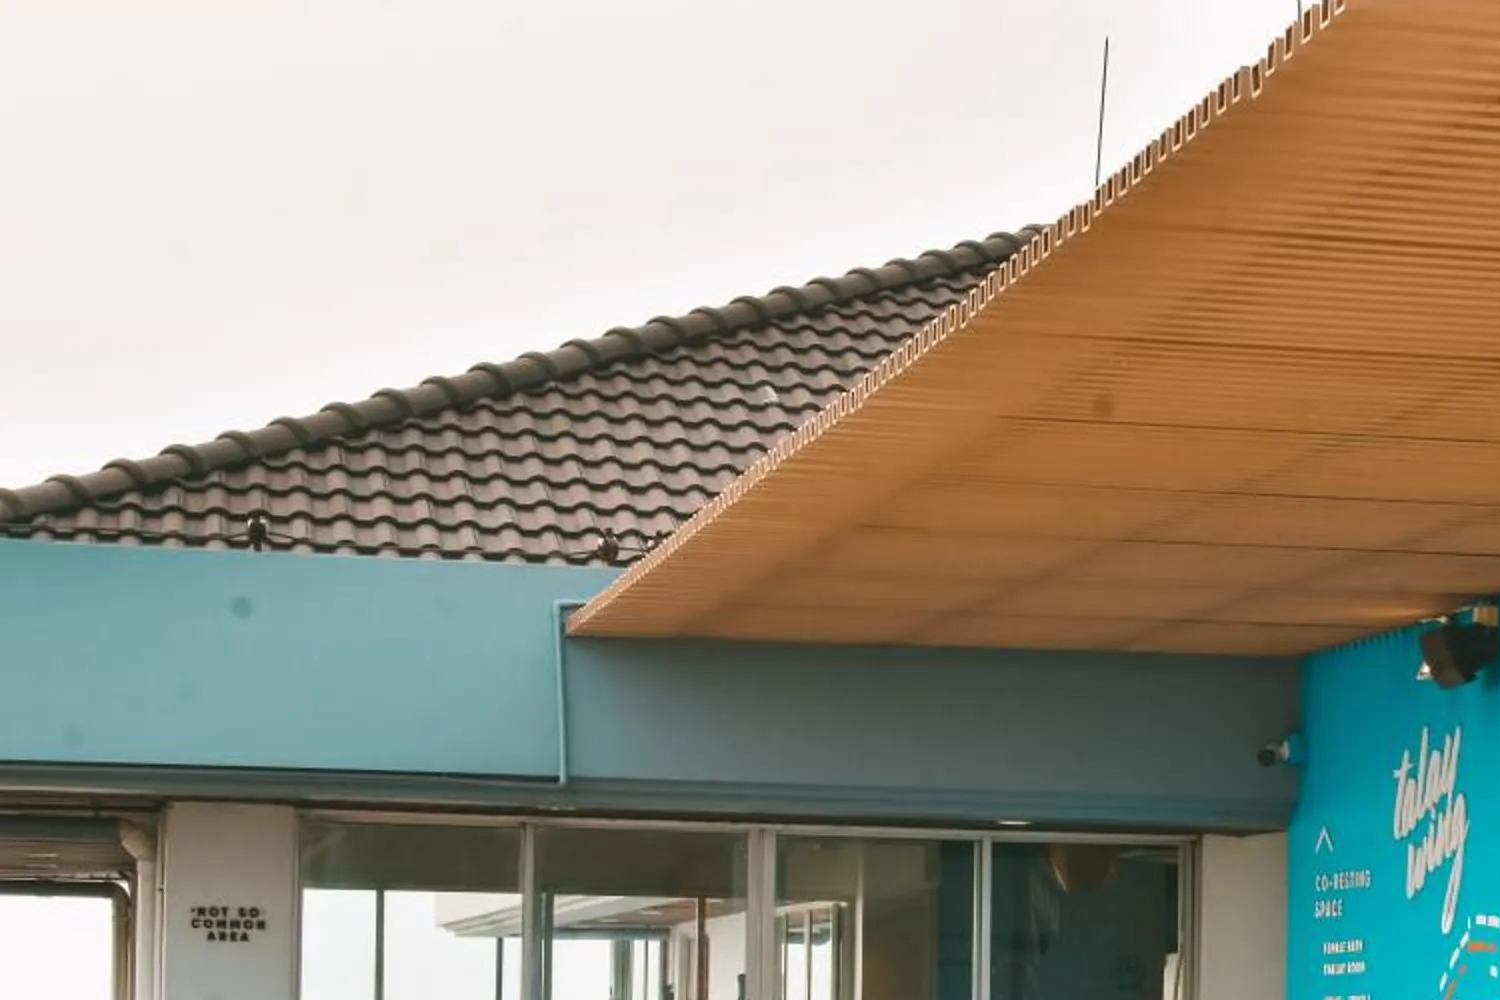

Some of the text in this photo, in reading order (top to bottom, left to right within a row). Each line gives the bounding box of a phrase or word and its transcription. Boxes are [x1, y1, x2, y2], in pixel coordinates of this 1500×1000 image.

[1314, 898, 1343, 919] SPACE
[191, 918, 267, 930] COMMON
[206, 931, 249, 942] AREA
